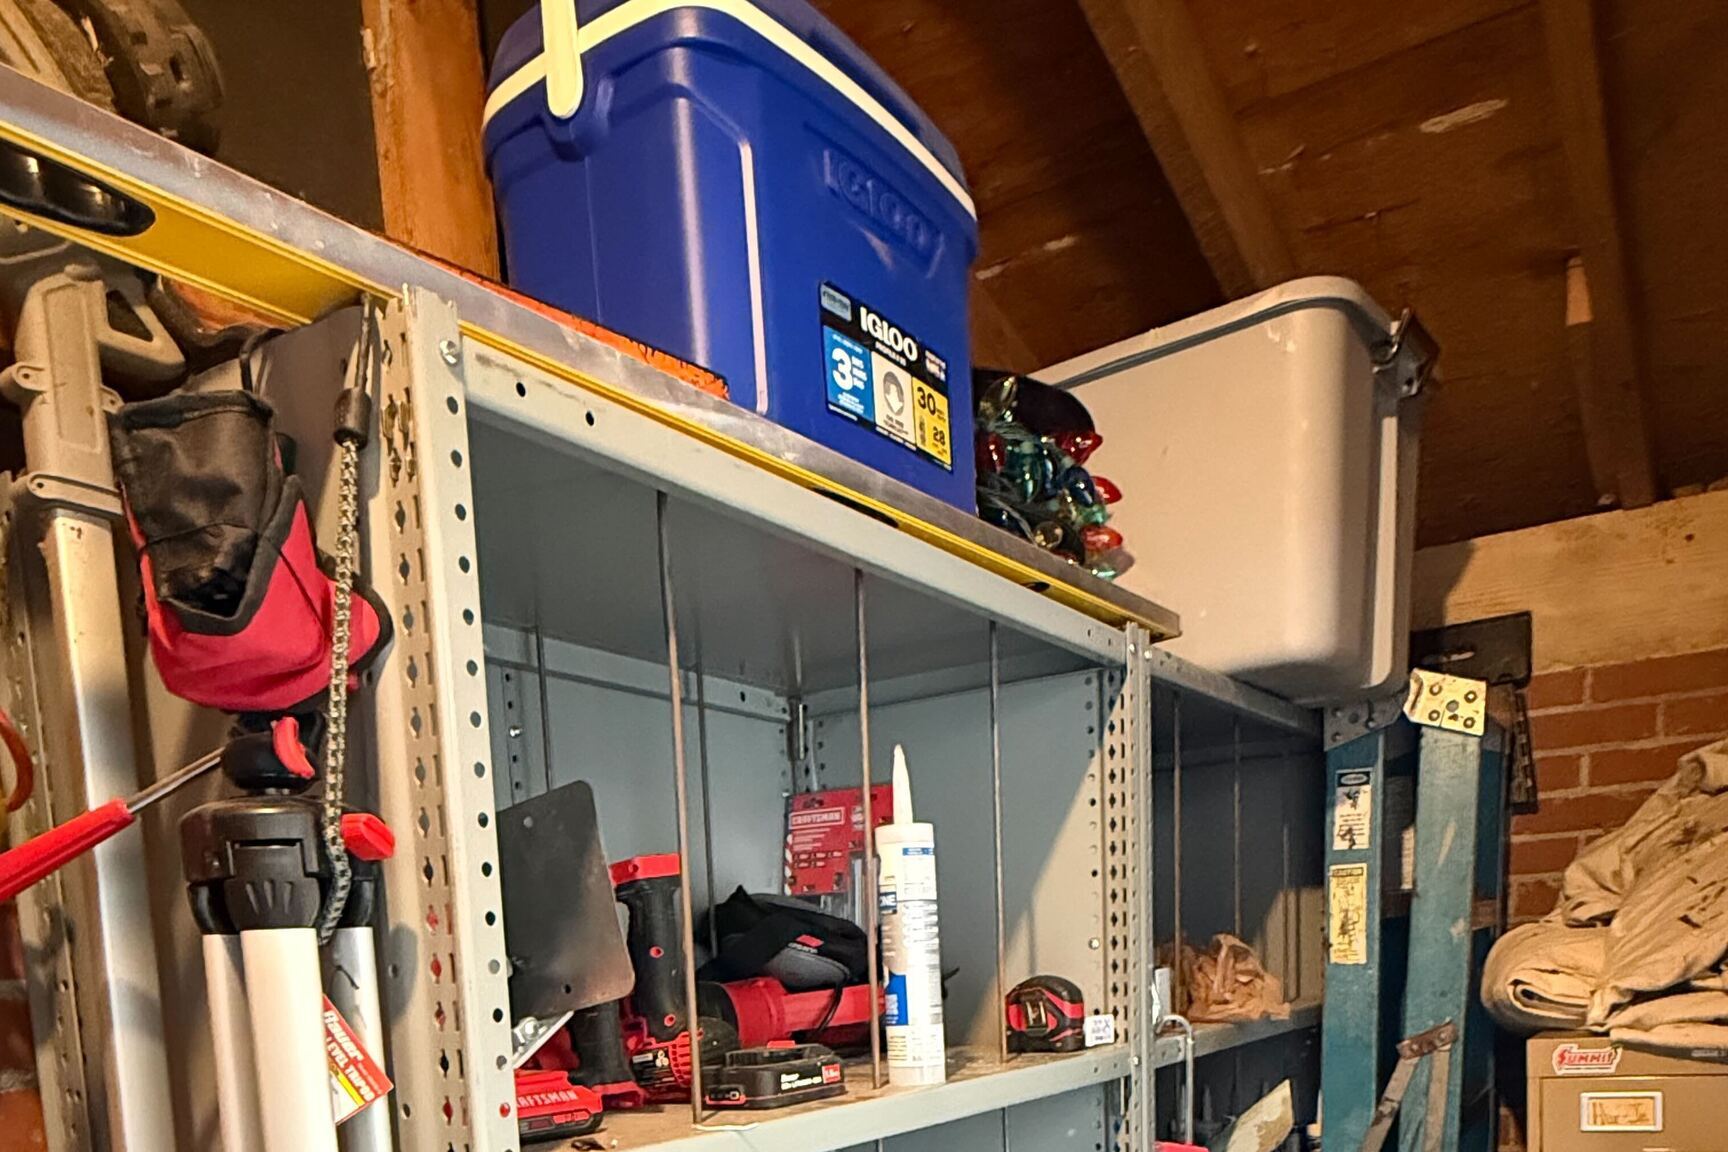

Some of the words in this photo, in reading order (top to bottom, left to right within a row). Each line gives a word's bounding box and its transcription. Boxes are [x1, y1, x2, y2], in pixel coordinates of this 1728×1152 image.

[860, 306, 918, 361] IGLOO
[831, 348, 853, 390] 3
[917, 386, 936, 416] 30
[933, 426, 946, 446] 28
[1558, 1049, 1616, 1066] SUMMIT
